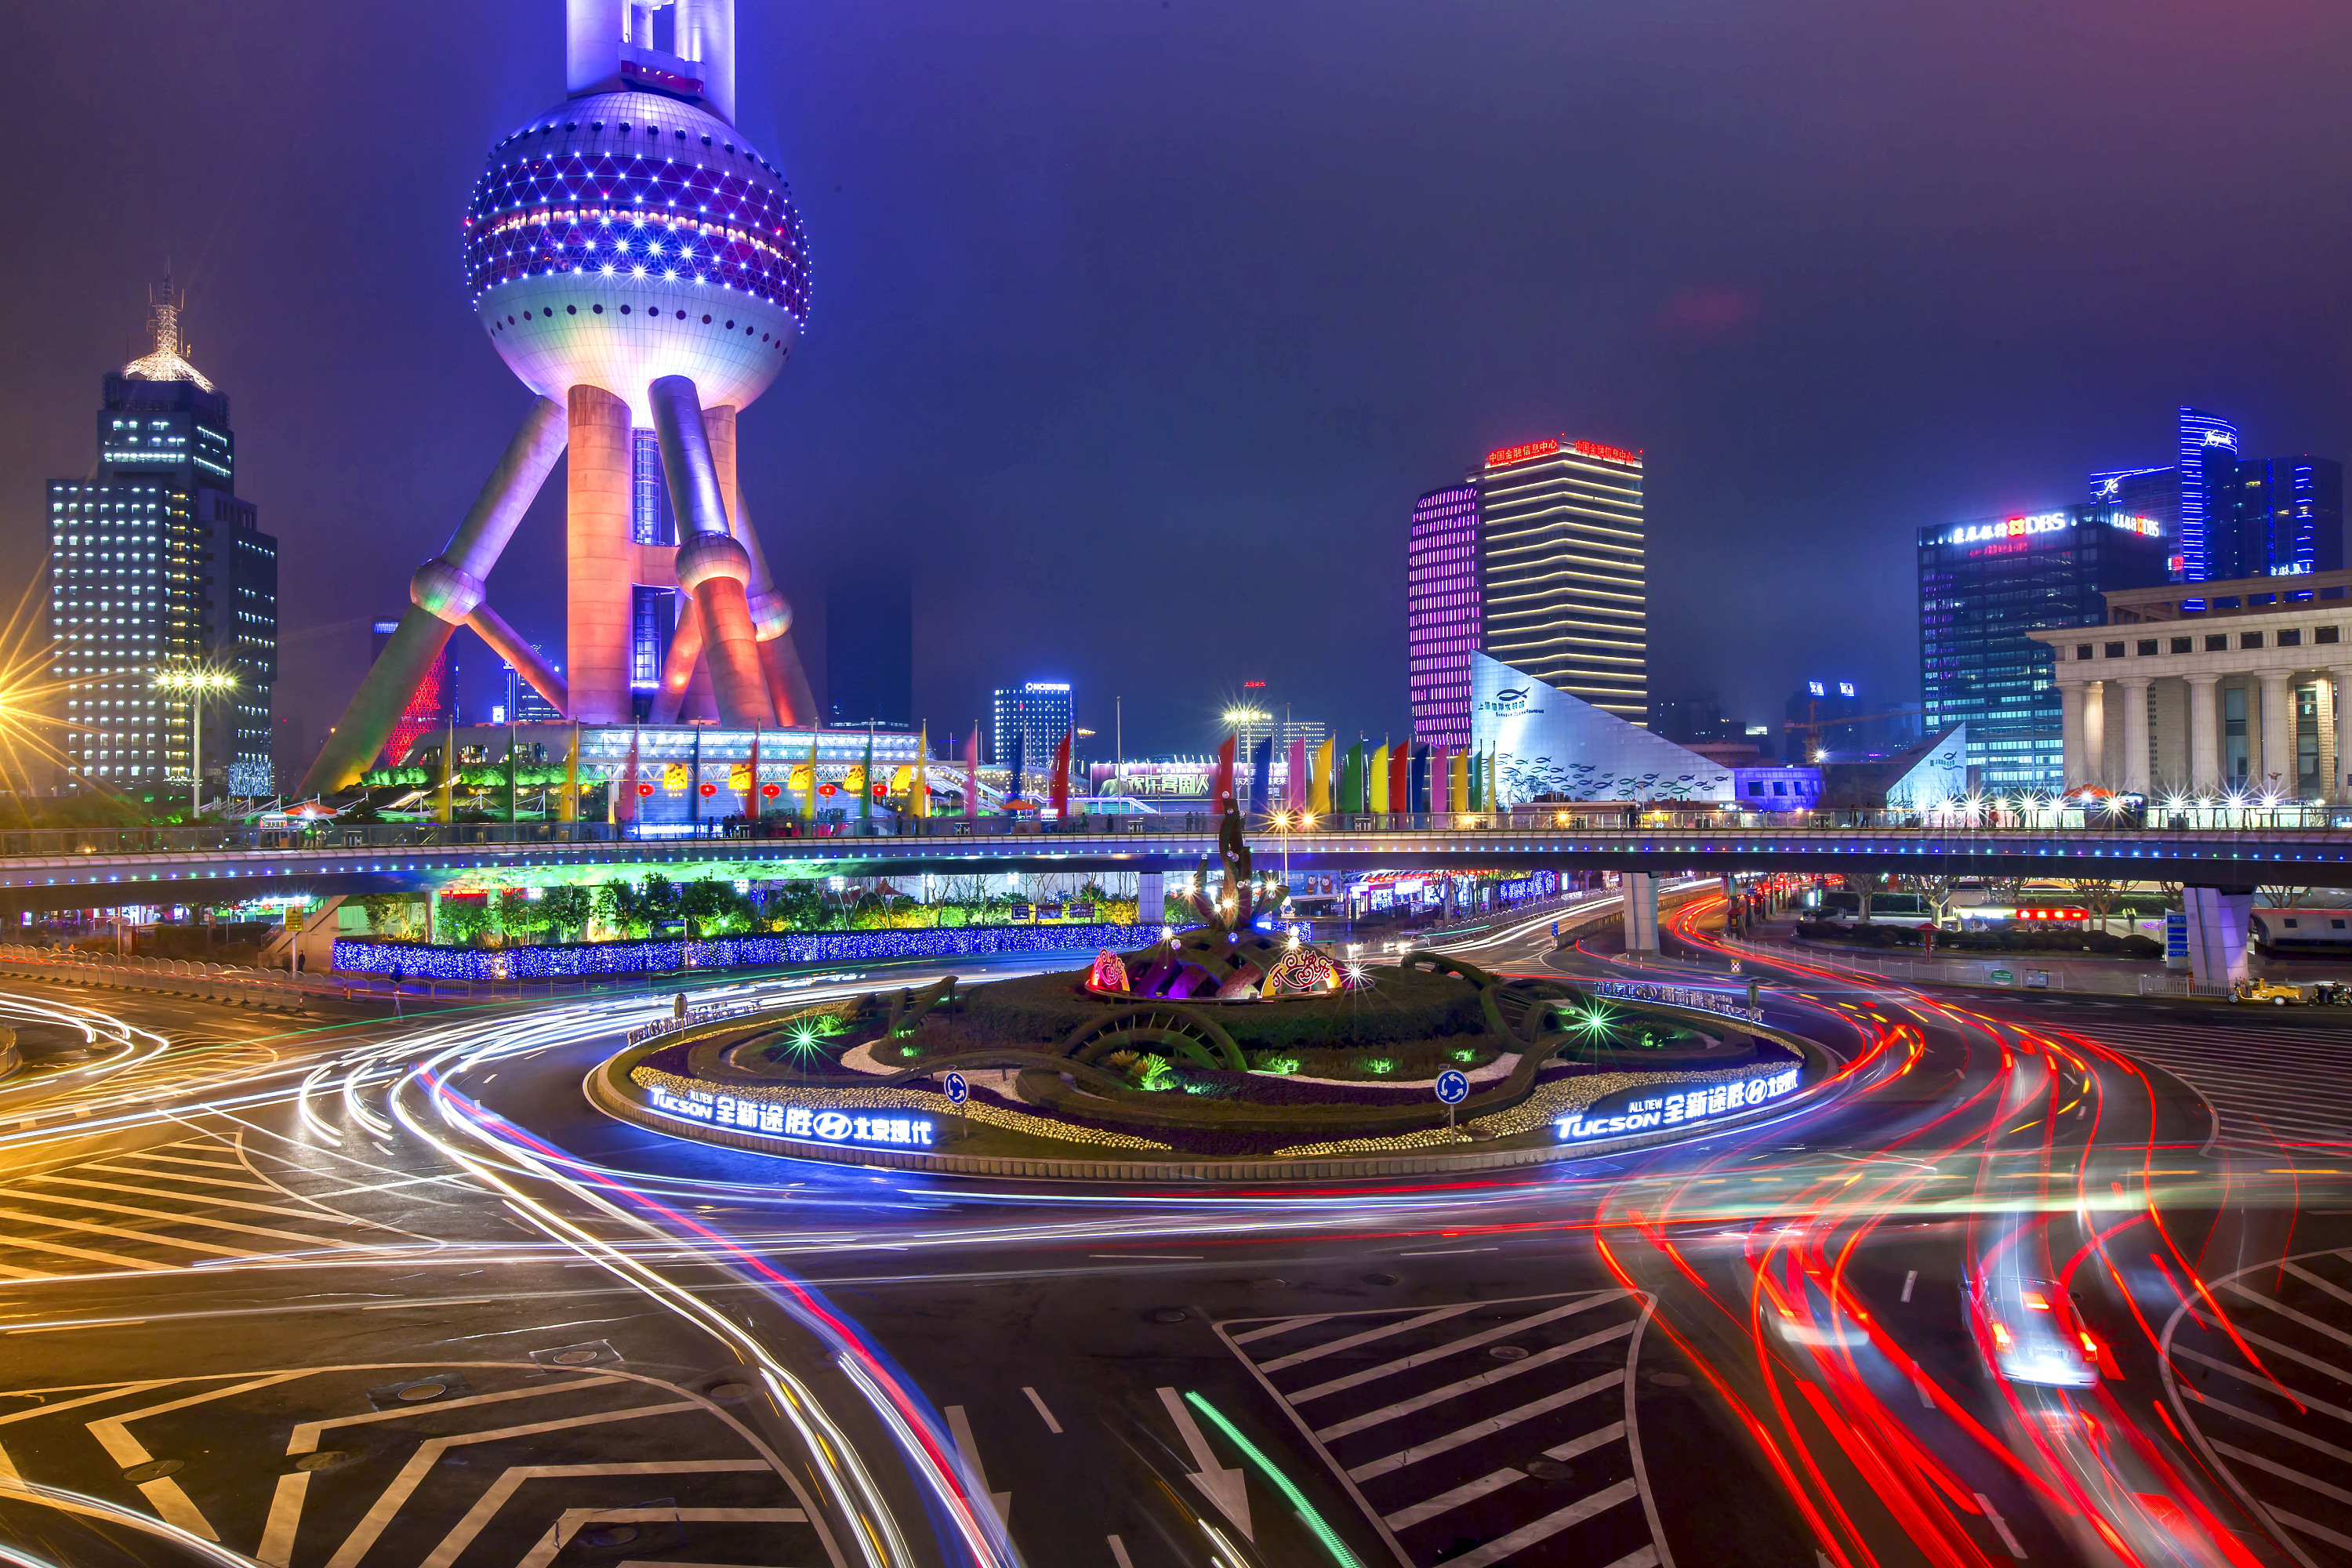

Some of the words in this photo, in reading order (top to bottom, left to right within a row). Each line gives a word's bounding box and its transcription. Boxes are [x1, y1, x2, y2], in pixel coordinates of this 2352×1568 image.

[1488, 439, 1559, 463] 中国金融信息中心
[1574, 440, 1635, 463] 中国金融信息中心
[2026, 513, 2066, 534] DBS
[2143, 519, 2159, 537] DBS
[1127, 774, 1210, 795] 欢乐喜剧人
[1664, 1082, 1745, 1123] 全新途胜
[1767, 1069, 1798, 1098] 北京现代
[1628, 1102, 1644, 1113] ALL
[716, 1097, 813, 1137] 全新途胜
[853, 1117, 932, 1145] 北京现代
